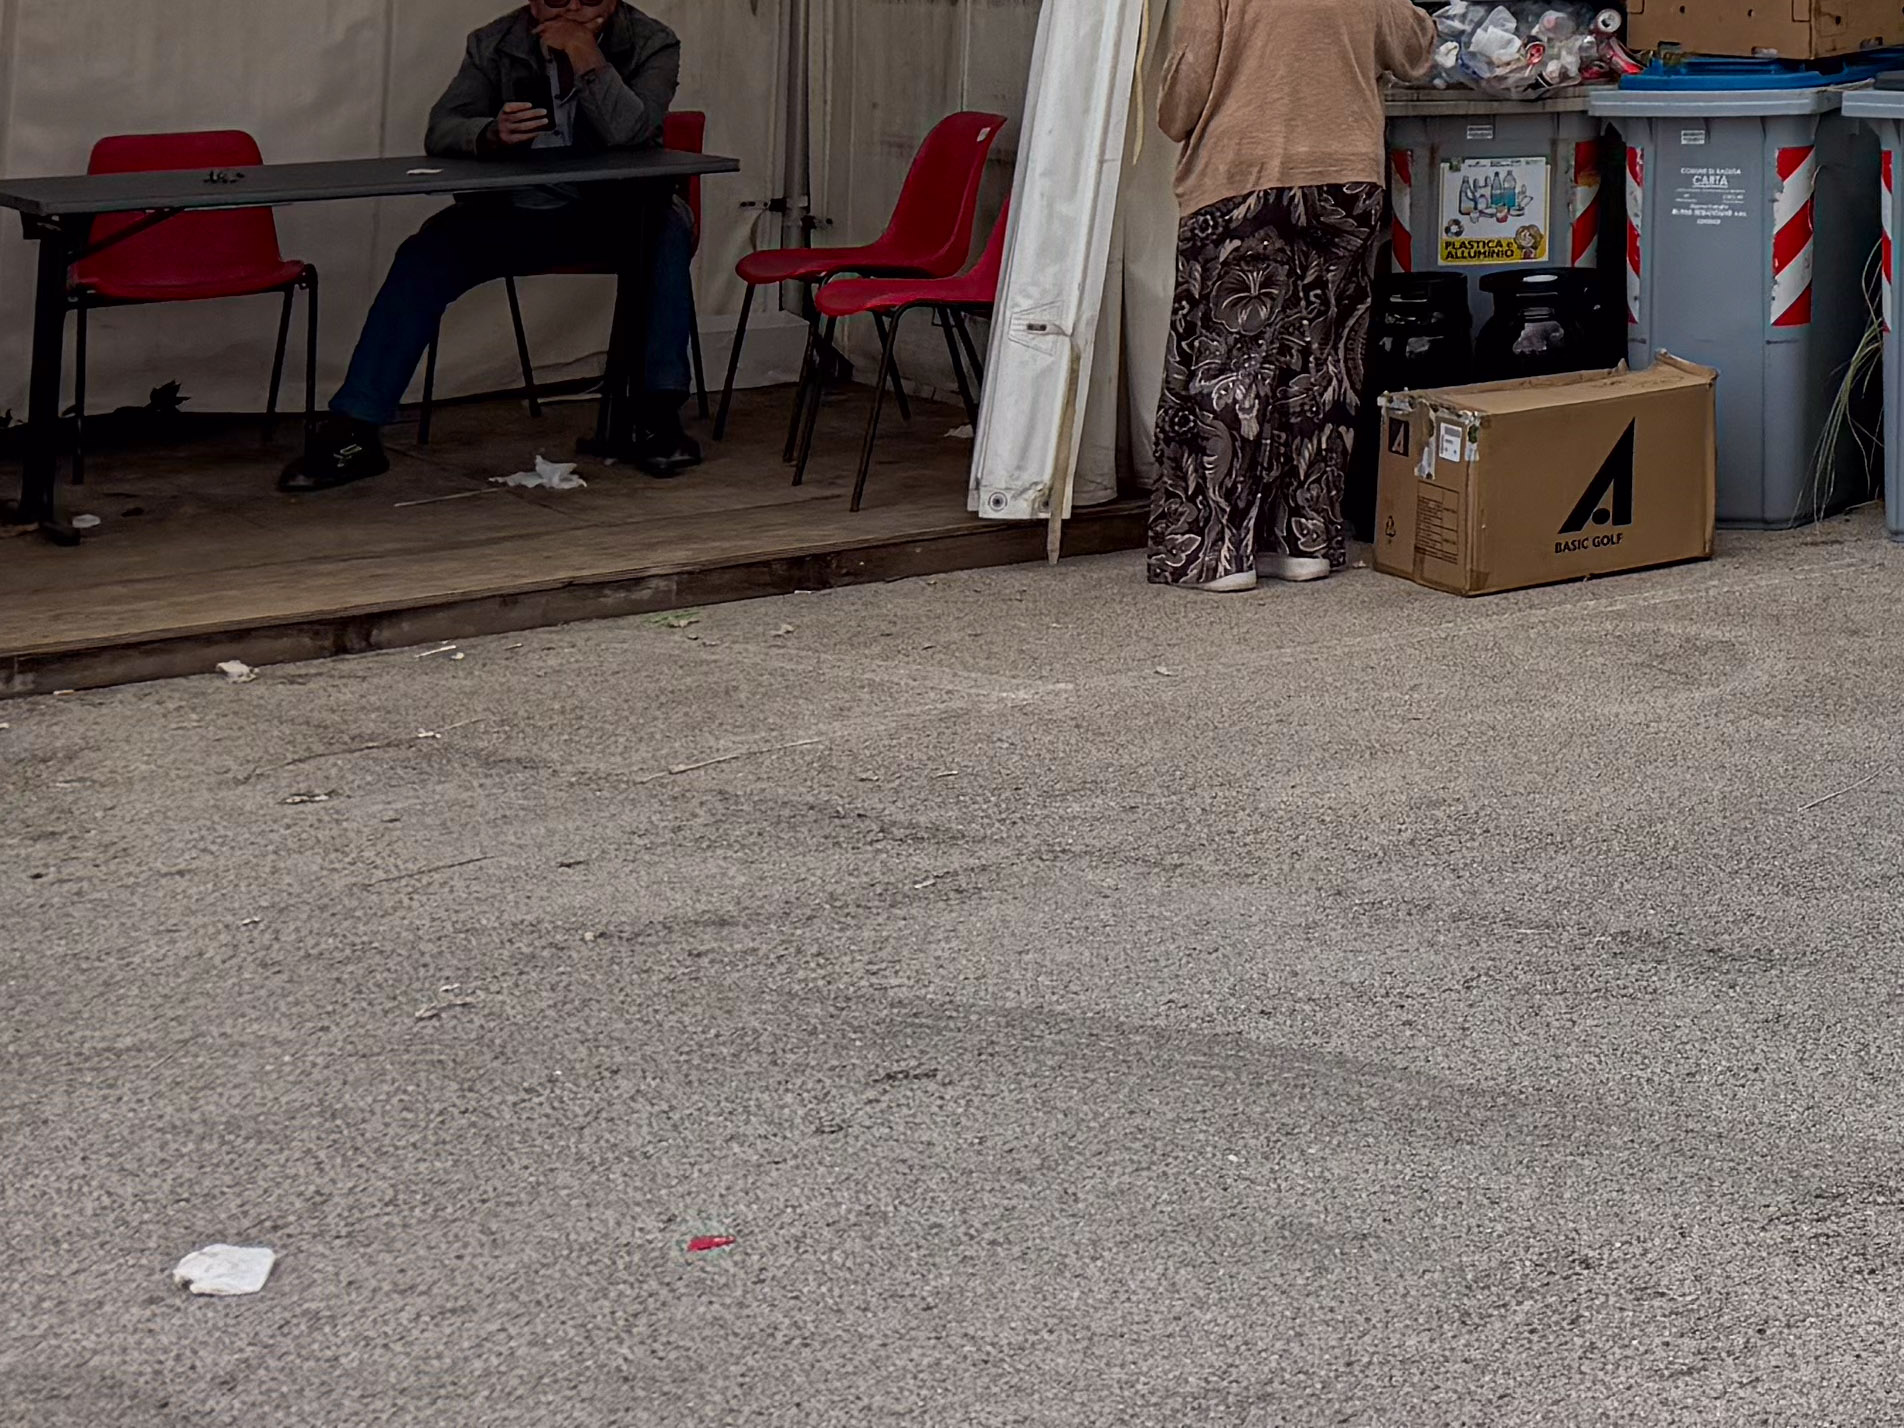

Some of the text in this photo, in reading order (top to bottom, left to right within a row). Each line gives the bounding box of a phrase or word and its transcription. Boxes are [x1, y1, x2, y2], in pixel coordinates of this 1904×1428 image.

[1692, 175, 1728, 186] CARTA
[1444, 240, 1504, 251] PLASTICA
[1445, 248, 1515, 261] ALLUMINIO
[1554, 532, 1624, 554] BASIC GOLF
